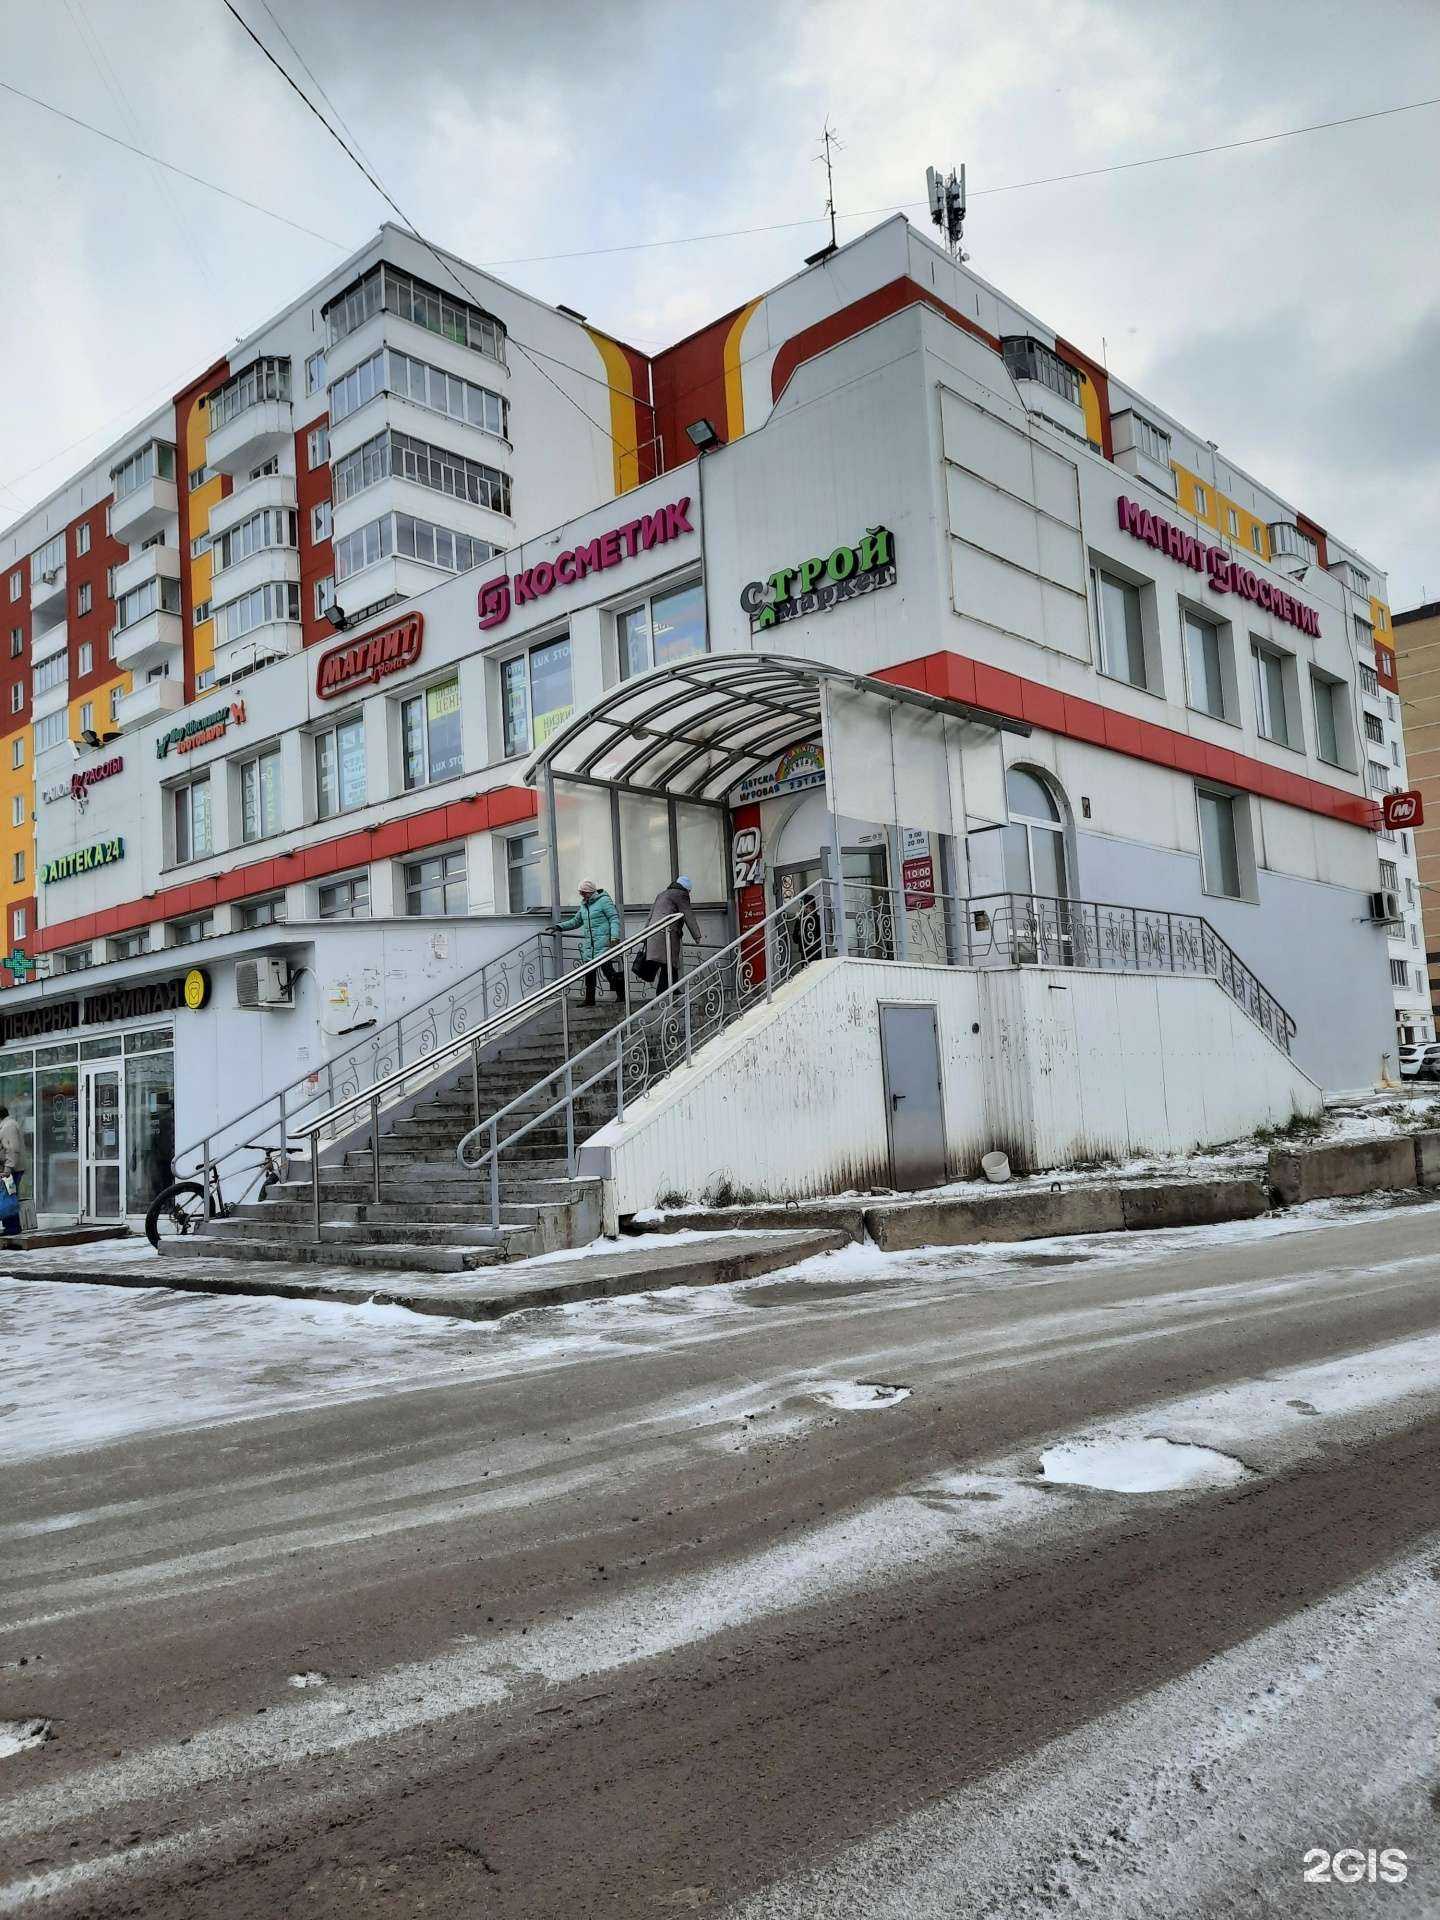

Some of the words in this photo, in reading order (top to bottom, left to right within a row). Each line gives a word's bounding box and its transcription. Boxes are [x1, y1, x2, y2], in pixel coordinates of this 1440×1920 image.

[514, 497, 694, 605] КОСМЕТИК
[741, 525, 893, 613] СТРОЙ
[1118, 496, 1206, 572] МАГНИТ
[1231, 563, 1321, 638] КОСМЕТИК
[321, 623, 417, 688] МАГНИТ
[533, 655, 550, 669] LUX
[432, 761, 447, 773] LUX
[49, 843, 103, 882] АПТЕКА
[105, 837, 123, 862] 24
[734, 858, 764, 888] 24
[3, 1001, 74, 1040] ПЕКАРНЯ
[84, 984, 180, 1024] ЛЮБИМАЯ
